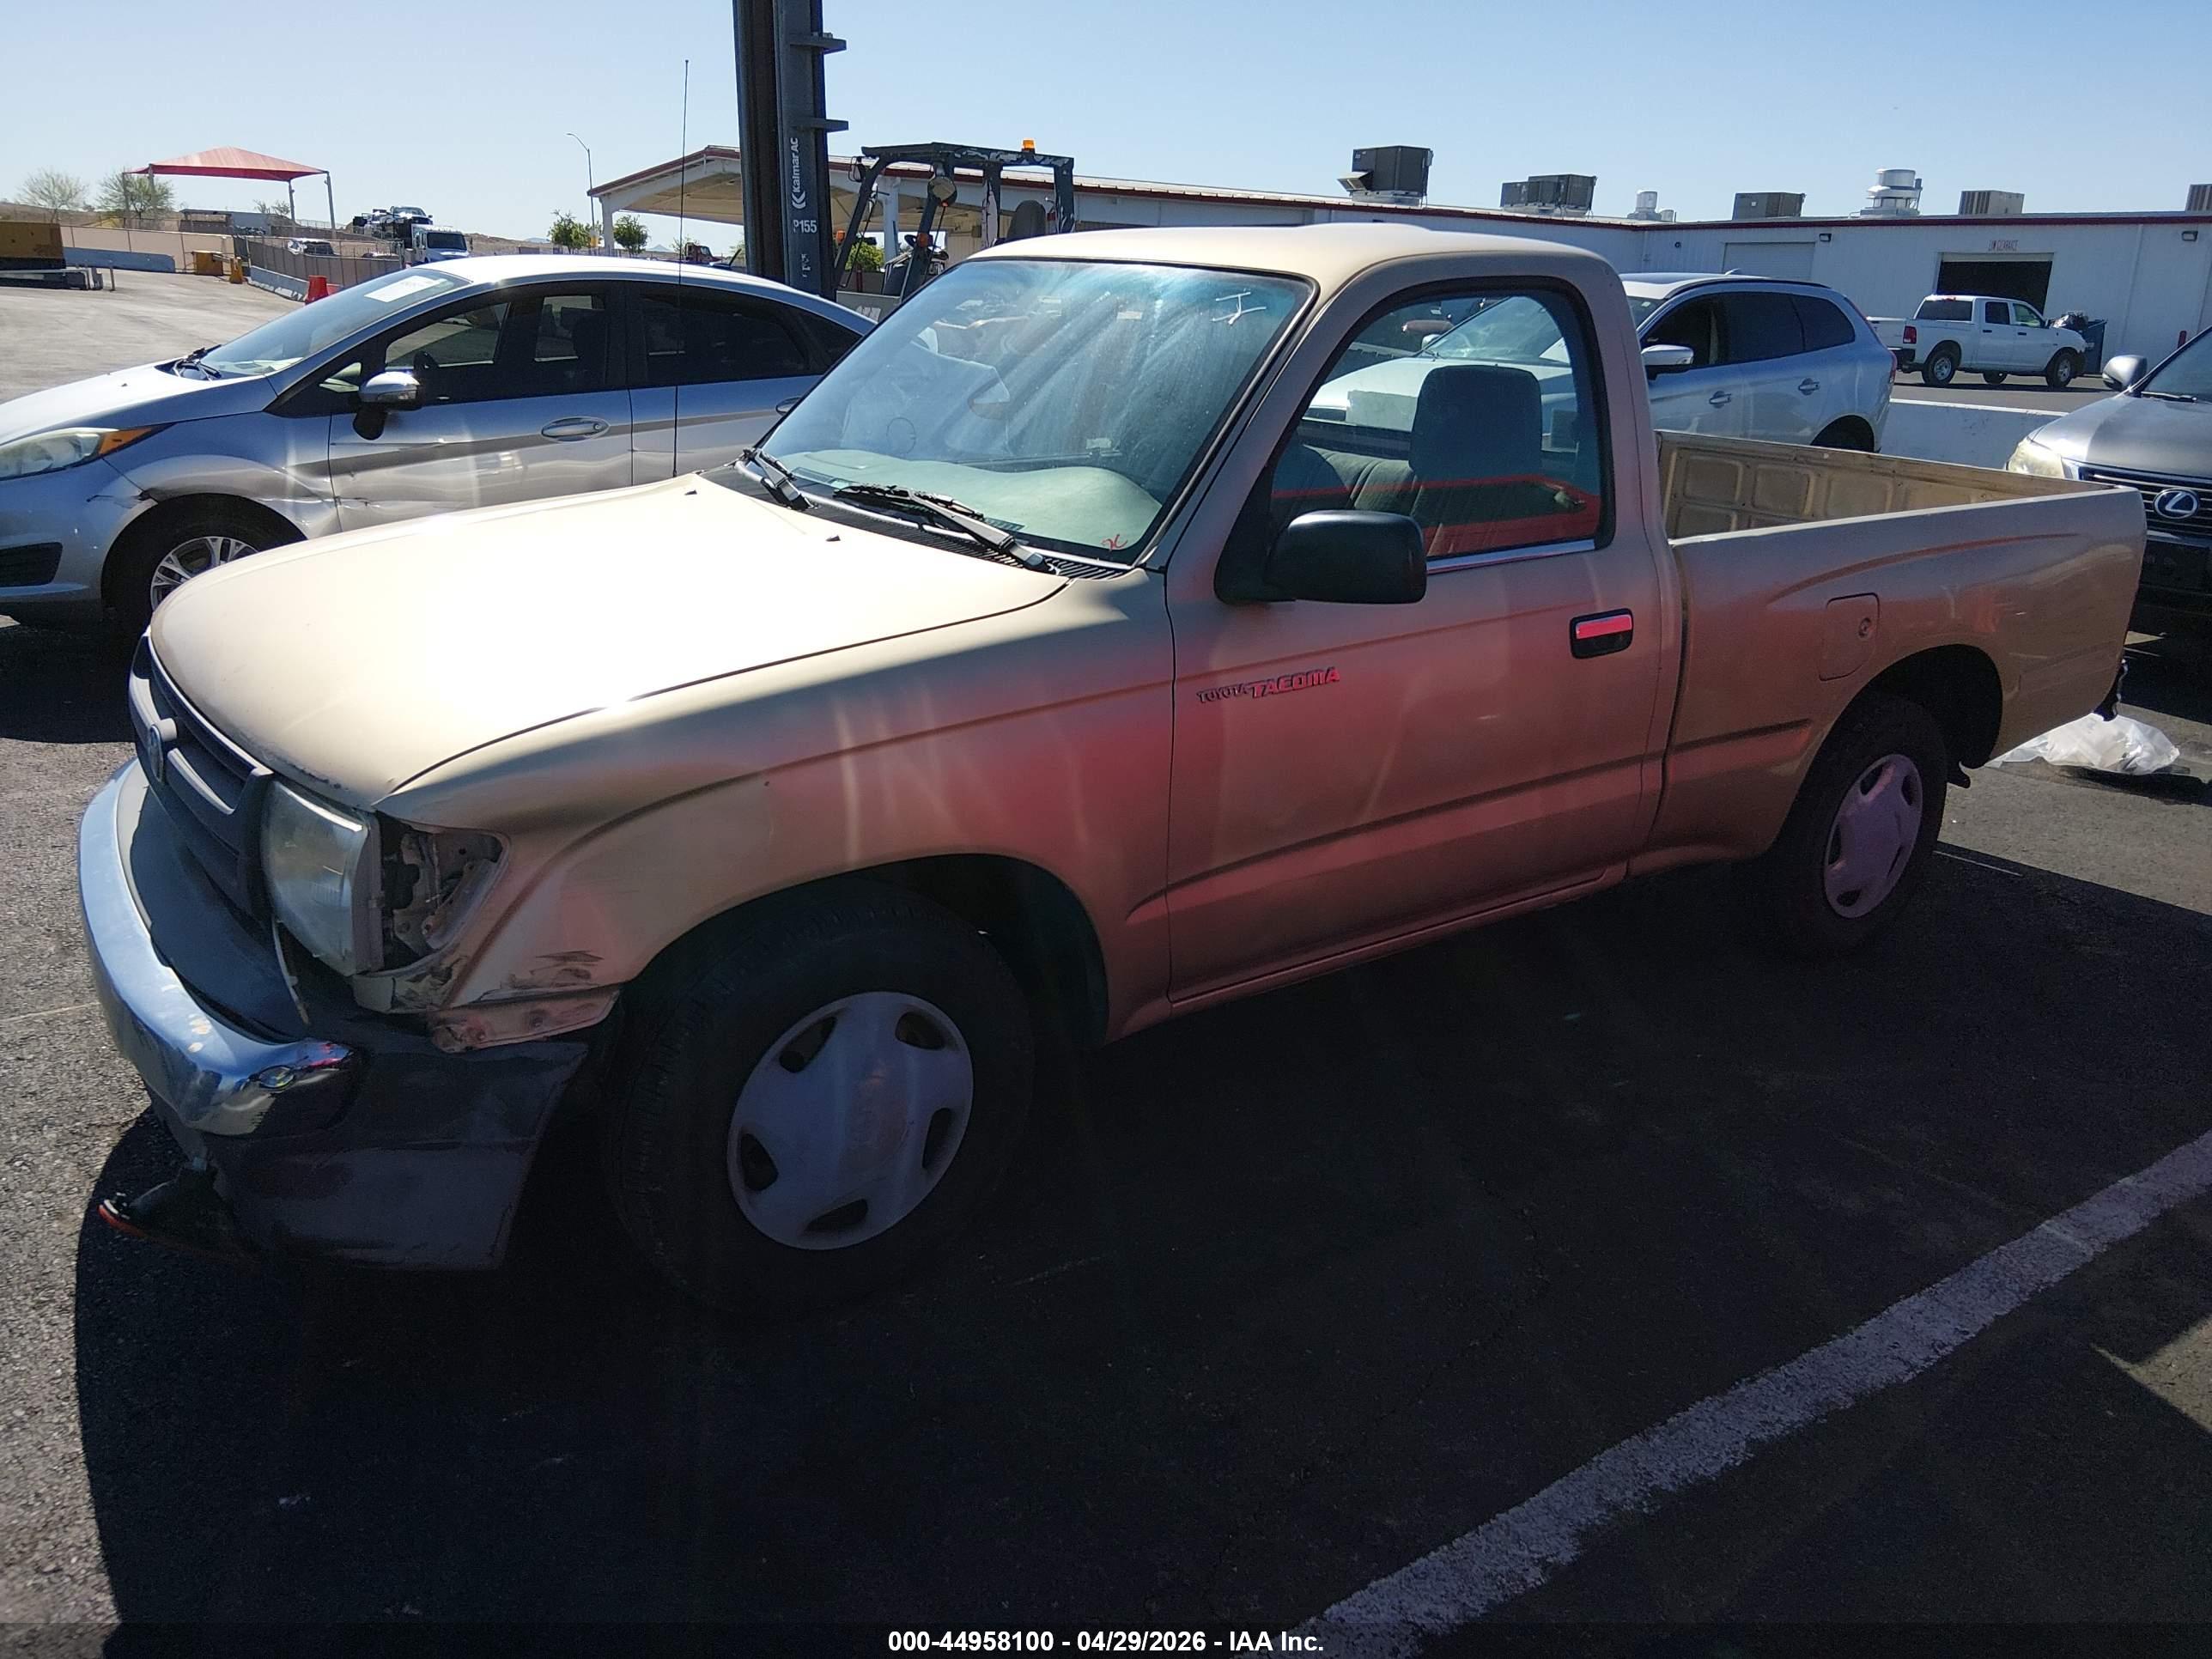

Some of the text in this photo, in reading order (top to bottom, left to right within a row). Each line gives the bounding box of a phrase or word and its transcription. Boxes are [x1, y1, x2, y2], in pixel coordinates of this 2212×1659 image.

[790, 137, 801, 193] Kalmar AC
[1249, 666, 1340, 698] TACOMA
